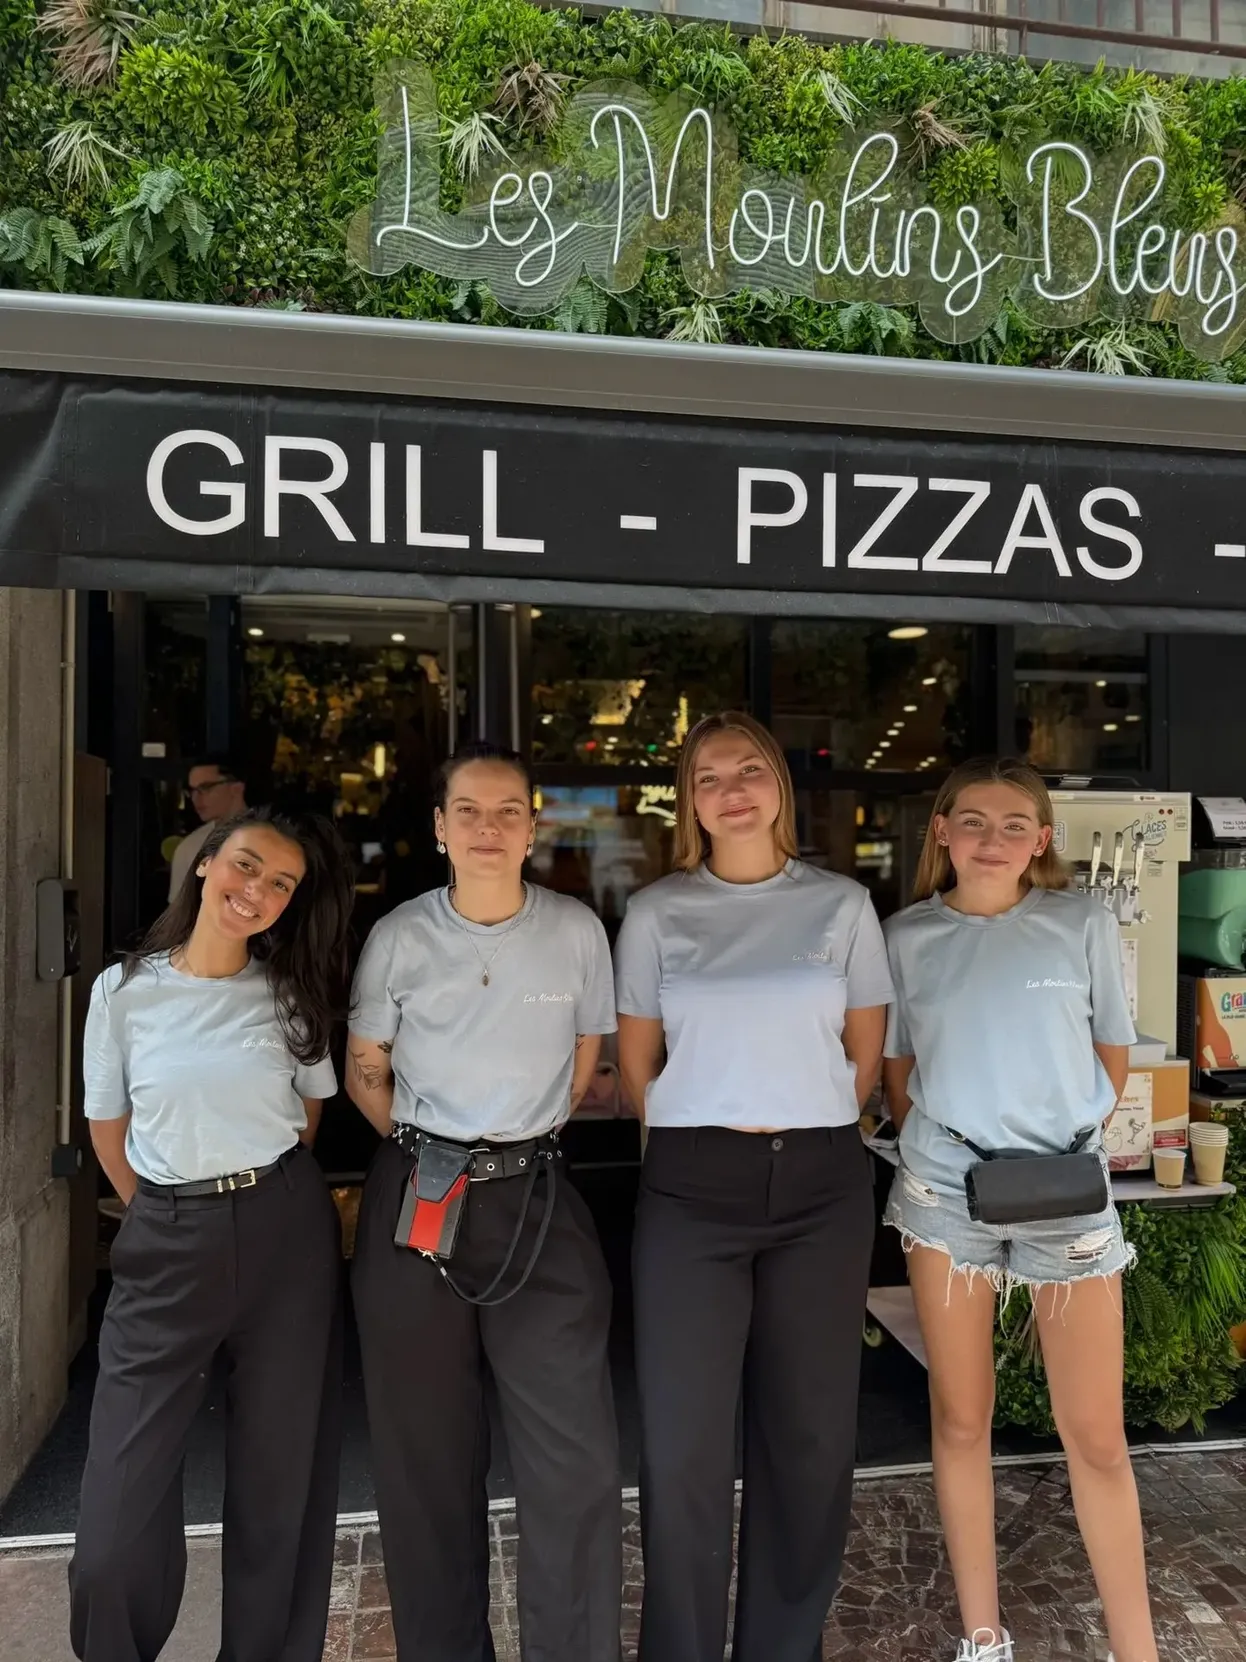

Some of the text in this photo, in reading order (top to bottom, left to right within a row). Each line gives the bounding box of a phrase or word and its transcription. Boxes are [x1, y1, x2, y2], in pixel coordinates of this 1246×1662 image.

[375, 85, 1246, 336] Les Moulins Bleus
[144, 428, 546, 554] GRILL
[736, 466, 1143, 581] PIZZAS
